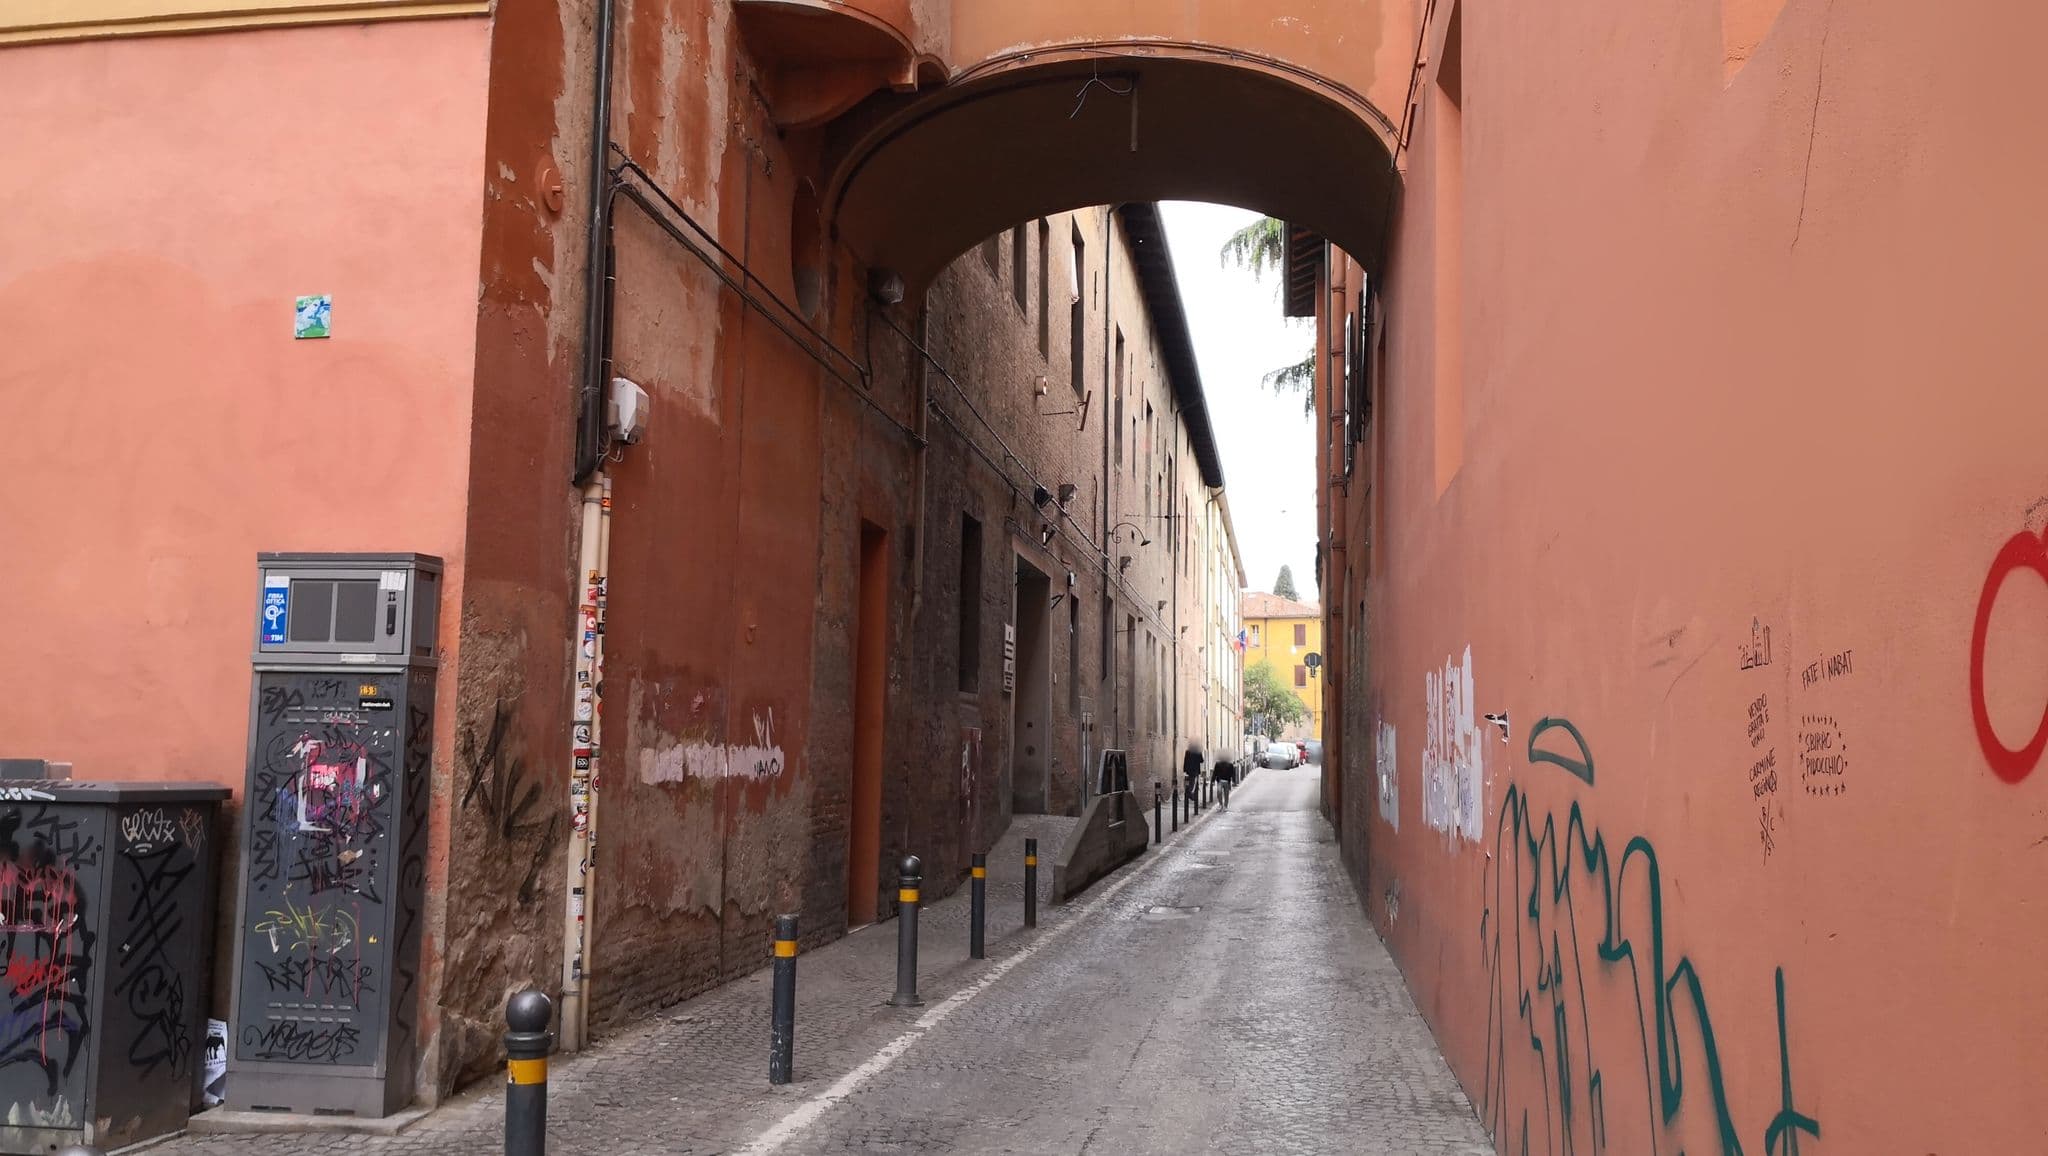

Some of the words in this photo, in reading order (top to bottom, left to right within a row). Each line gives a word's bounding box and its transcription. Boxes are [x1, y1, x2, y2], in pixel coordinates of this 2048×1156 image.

[271, 634, 284, 642] TIM
[1802, 663, 1818, 690] FATE
[1827, 650, 1853, 681] NABAT
[1748, 693, 1767, 719] VENDO
[1806, 754, 1844, 777] PIDOCCHIO
